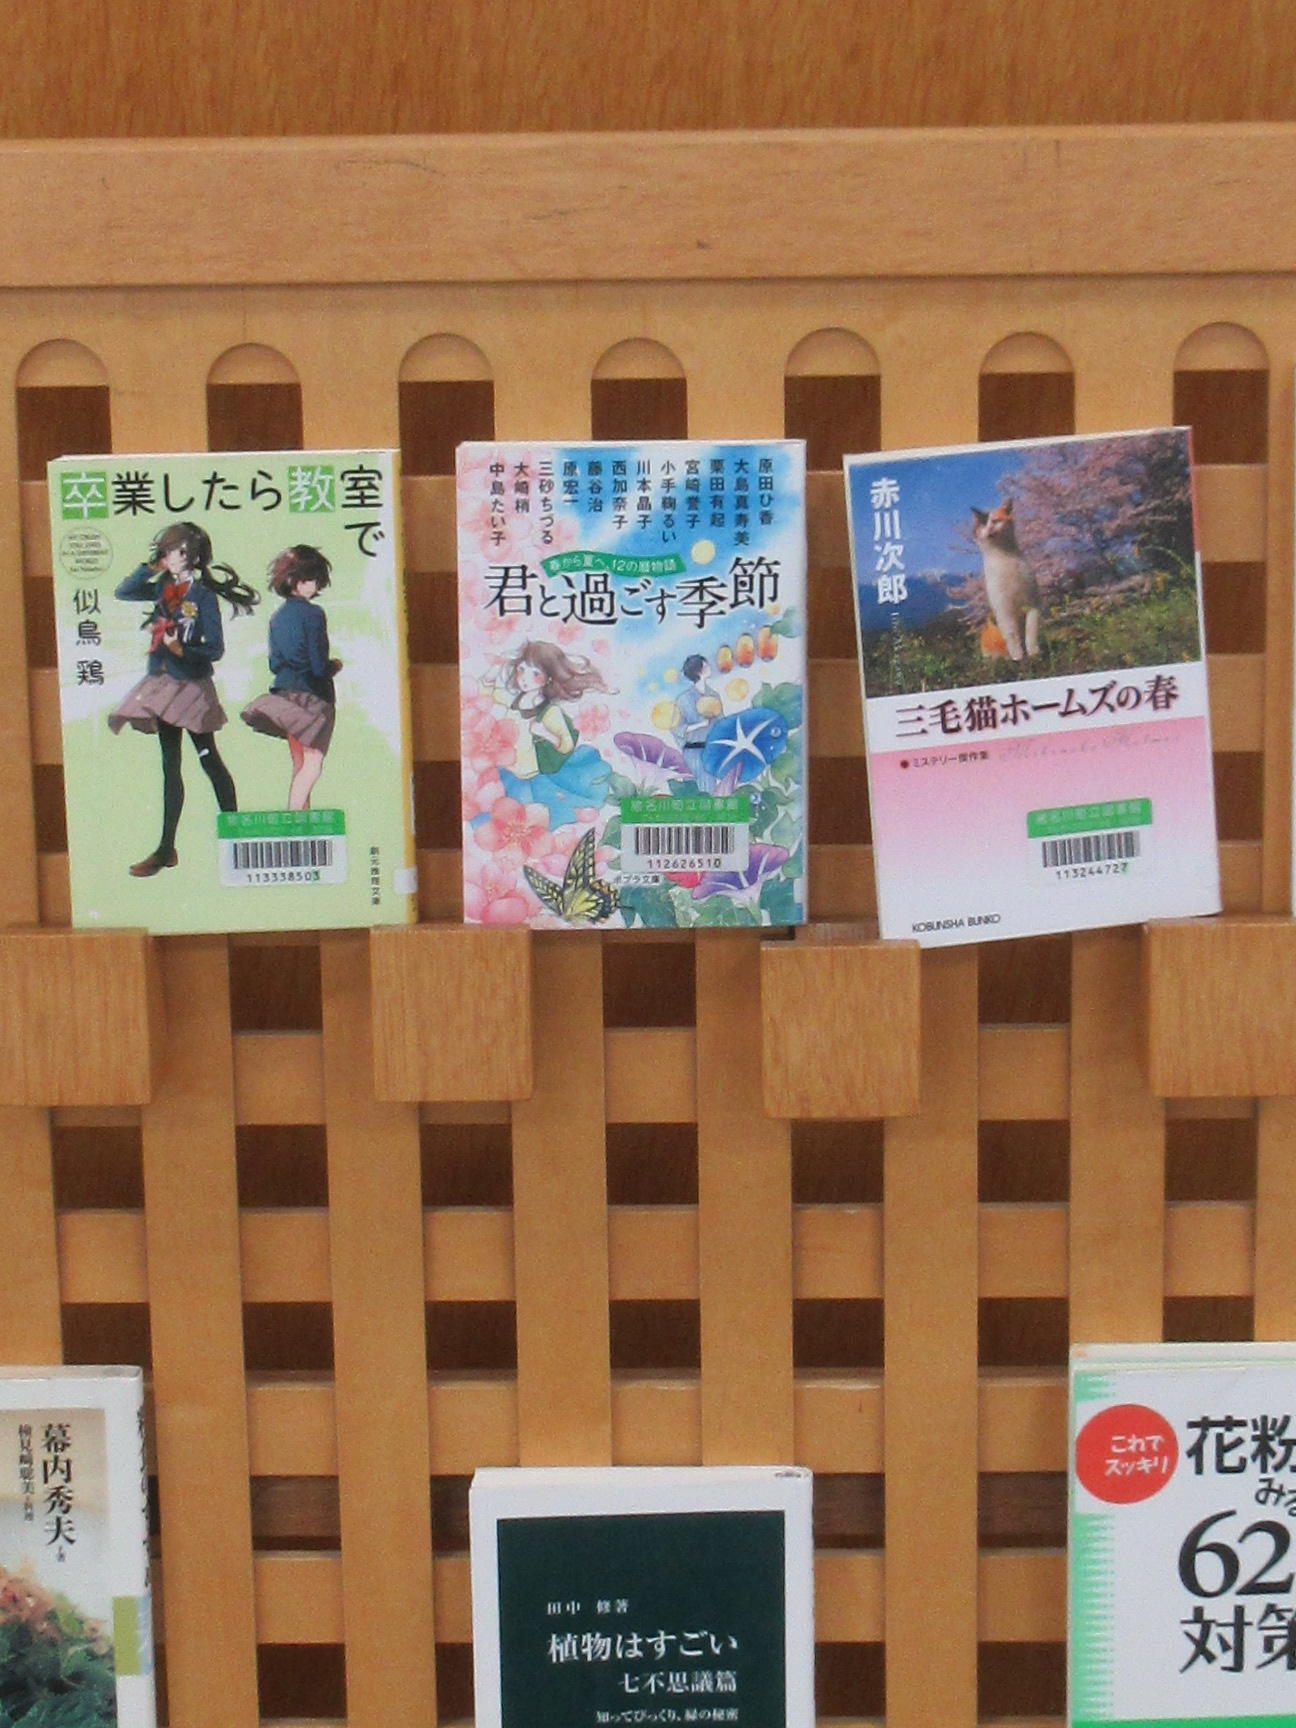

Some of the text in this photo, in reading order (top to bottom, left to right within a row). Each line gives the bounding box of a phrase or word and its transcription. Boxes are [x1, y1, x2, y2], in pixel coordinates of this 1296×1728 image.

[61, 464, 384, 518] 卒業したら教室
[563, 460, 579, 503] 原宏一
[612, 460, 628, 530] 西加奈子
[636, 459, 652, 529] 川本晶子
[489, 462, 506, 546] 中島たい子
[343, 522, 386, 558] で
[870, 477, 909, 605] 赤川次郎
[483, 555, 781, 629] 君と過ごす季節
[73, 588, 102, 647] 似鳥
[76, 660, 105, 686] 鶏
[895, 674, 1179, 740] 三毛猫ホームズの春
[247, 871, 321, 883] 113338503
[648, 858, 722, 869] 112626510
[912, 913, 1002, 933] KOBUNSHA BUNKO
[1110, 1434, 1166, 1455] これで
[41, 1423, 76, 1545] 幕内秀夫
[1104, 1457, 1170, 1476] スッキリ
[547, 1600, 581, 1616] 田中
[548, 1629, 739, 1663] 植物はすごい
[618, 1670, 738, 1695] 七不思議篇
